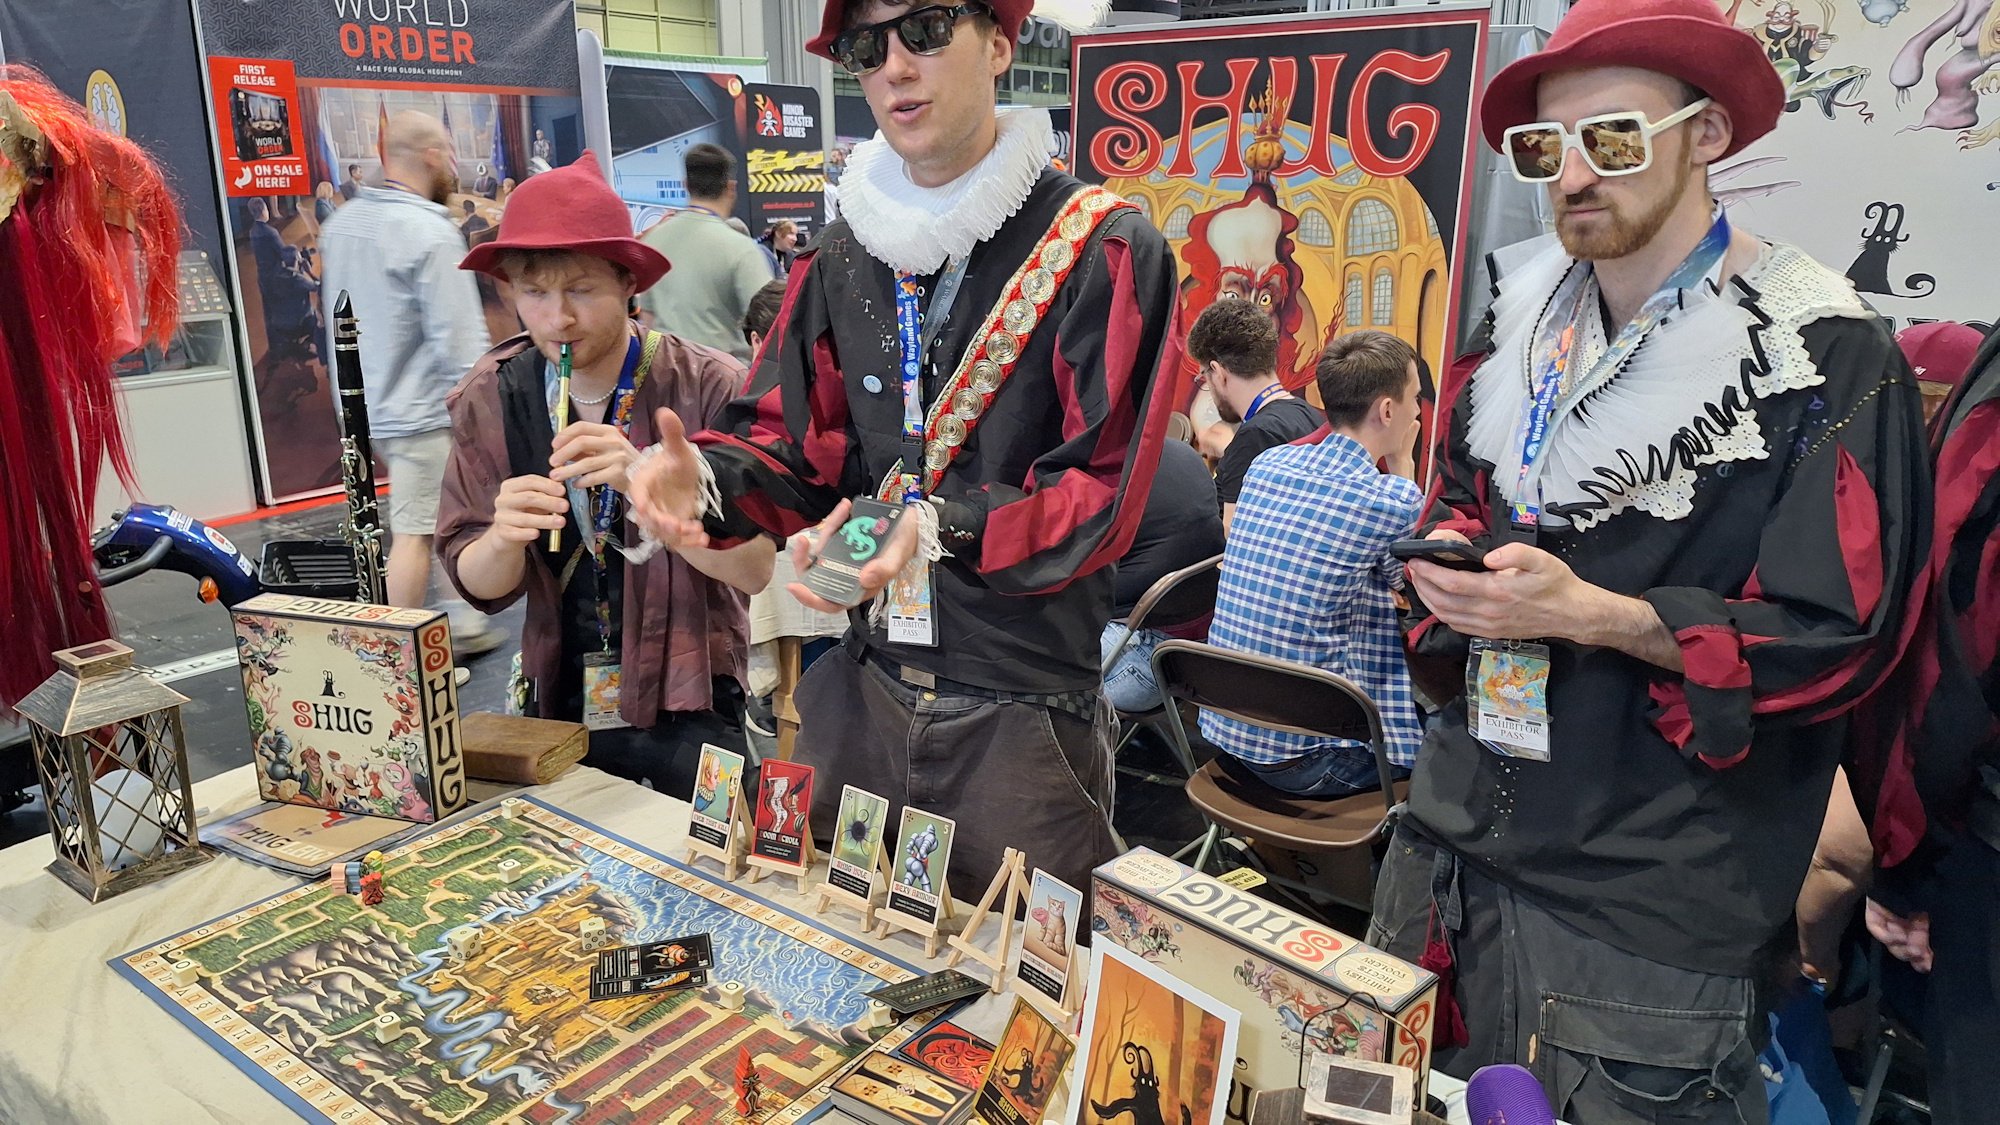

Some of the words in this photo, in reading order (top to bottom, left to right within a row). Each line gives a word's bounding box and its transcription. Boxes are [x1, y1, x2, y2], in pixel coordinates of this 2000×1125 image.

[335, 0, 469, 27] WORLD
[339, 23, 476, 64] ORDER
[239, 64, 266, 75] FIRST
[399, 67, 425, 75] GLOBAL
[233, 75, 276, 86] RELEASE
[782, 103, 804, 115] MINOR
[1089, 48, 1451, 178] SHUG
[783, 115, 814, 128] DISASTER
[783, 126, 806, 138] GAMES
[255, 136, 282, 147] WORLD
[257, 145, 284, 154] ORDER
[254, 165, 271, 175] ON
[274, 164, 303, 175] SALE
[256, 177, 290, 188] HERE!
[904, 300, 913, 327] Games
[906, 328, 917, 360] Wayland
[1532, 403, 1547, 442] Wayland
[1540, 377, 1557, 405] Games
[283, 601, 393, 619] SHUG
[893, 620, 927, 629] EXHIBITOR
[902, 629, 918, 637] PASS
[292, 700, 374, 735] SHUG
[423, 624, 462, 809] SHUG
[1486, 718, 1540, 735] EXHIBITOR
[1500, 730, 1525, 740] PASS
[777, 834, 800, 846] SCROLL
[895, 883, 911, 895] SEXY
[1167, 882, 1342, 962] SHUG
[1357, 965, 1395, 985] MEETS
[1361, 957, 1407, 979] FOOLERY
[1345, 969, 1391, 993] FANTASY
[998, 1096, 1018, 1120] SHUG
